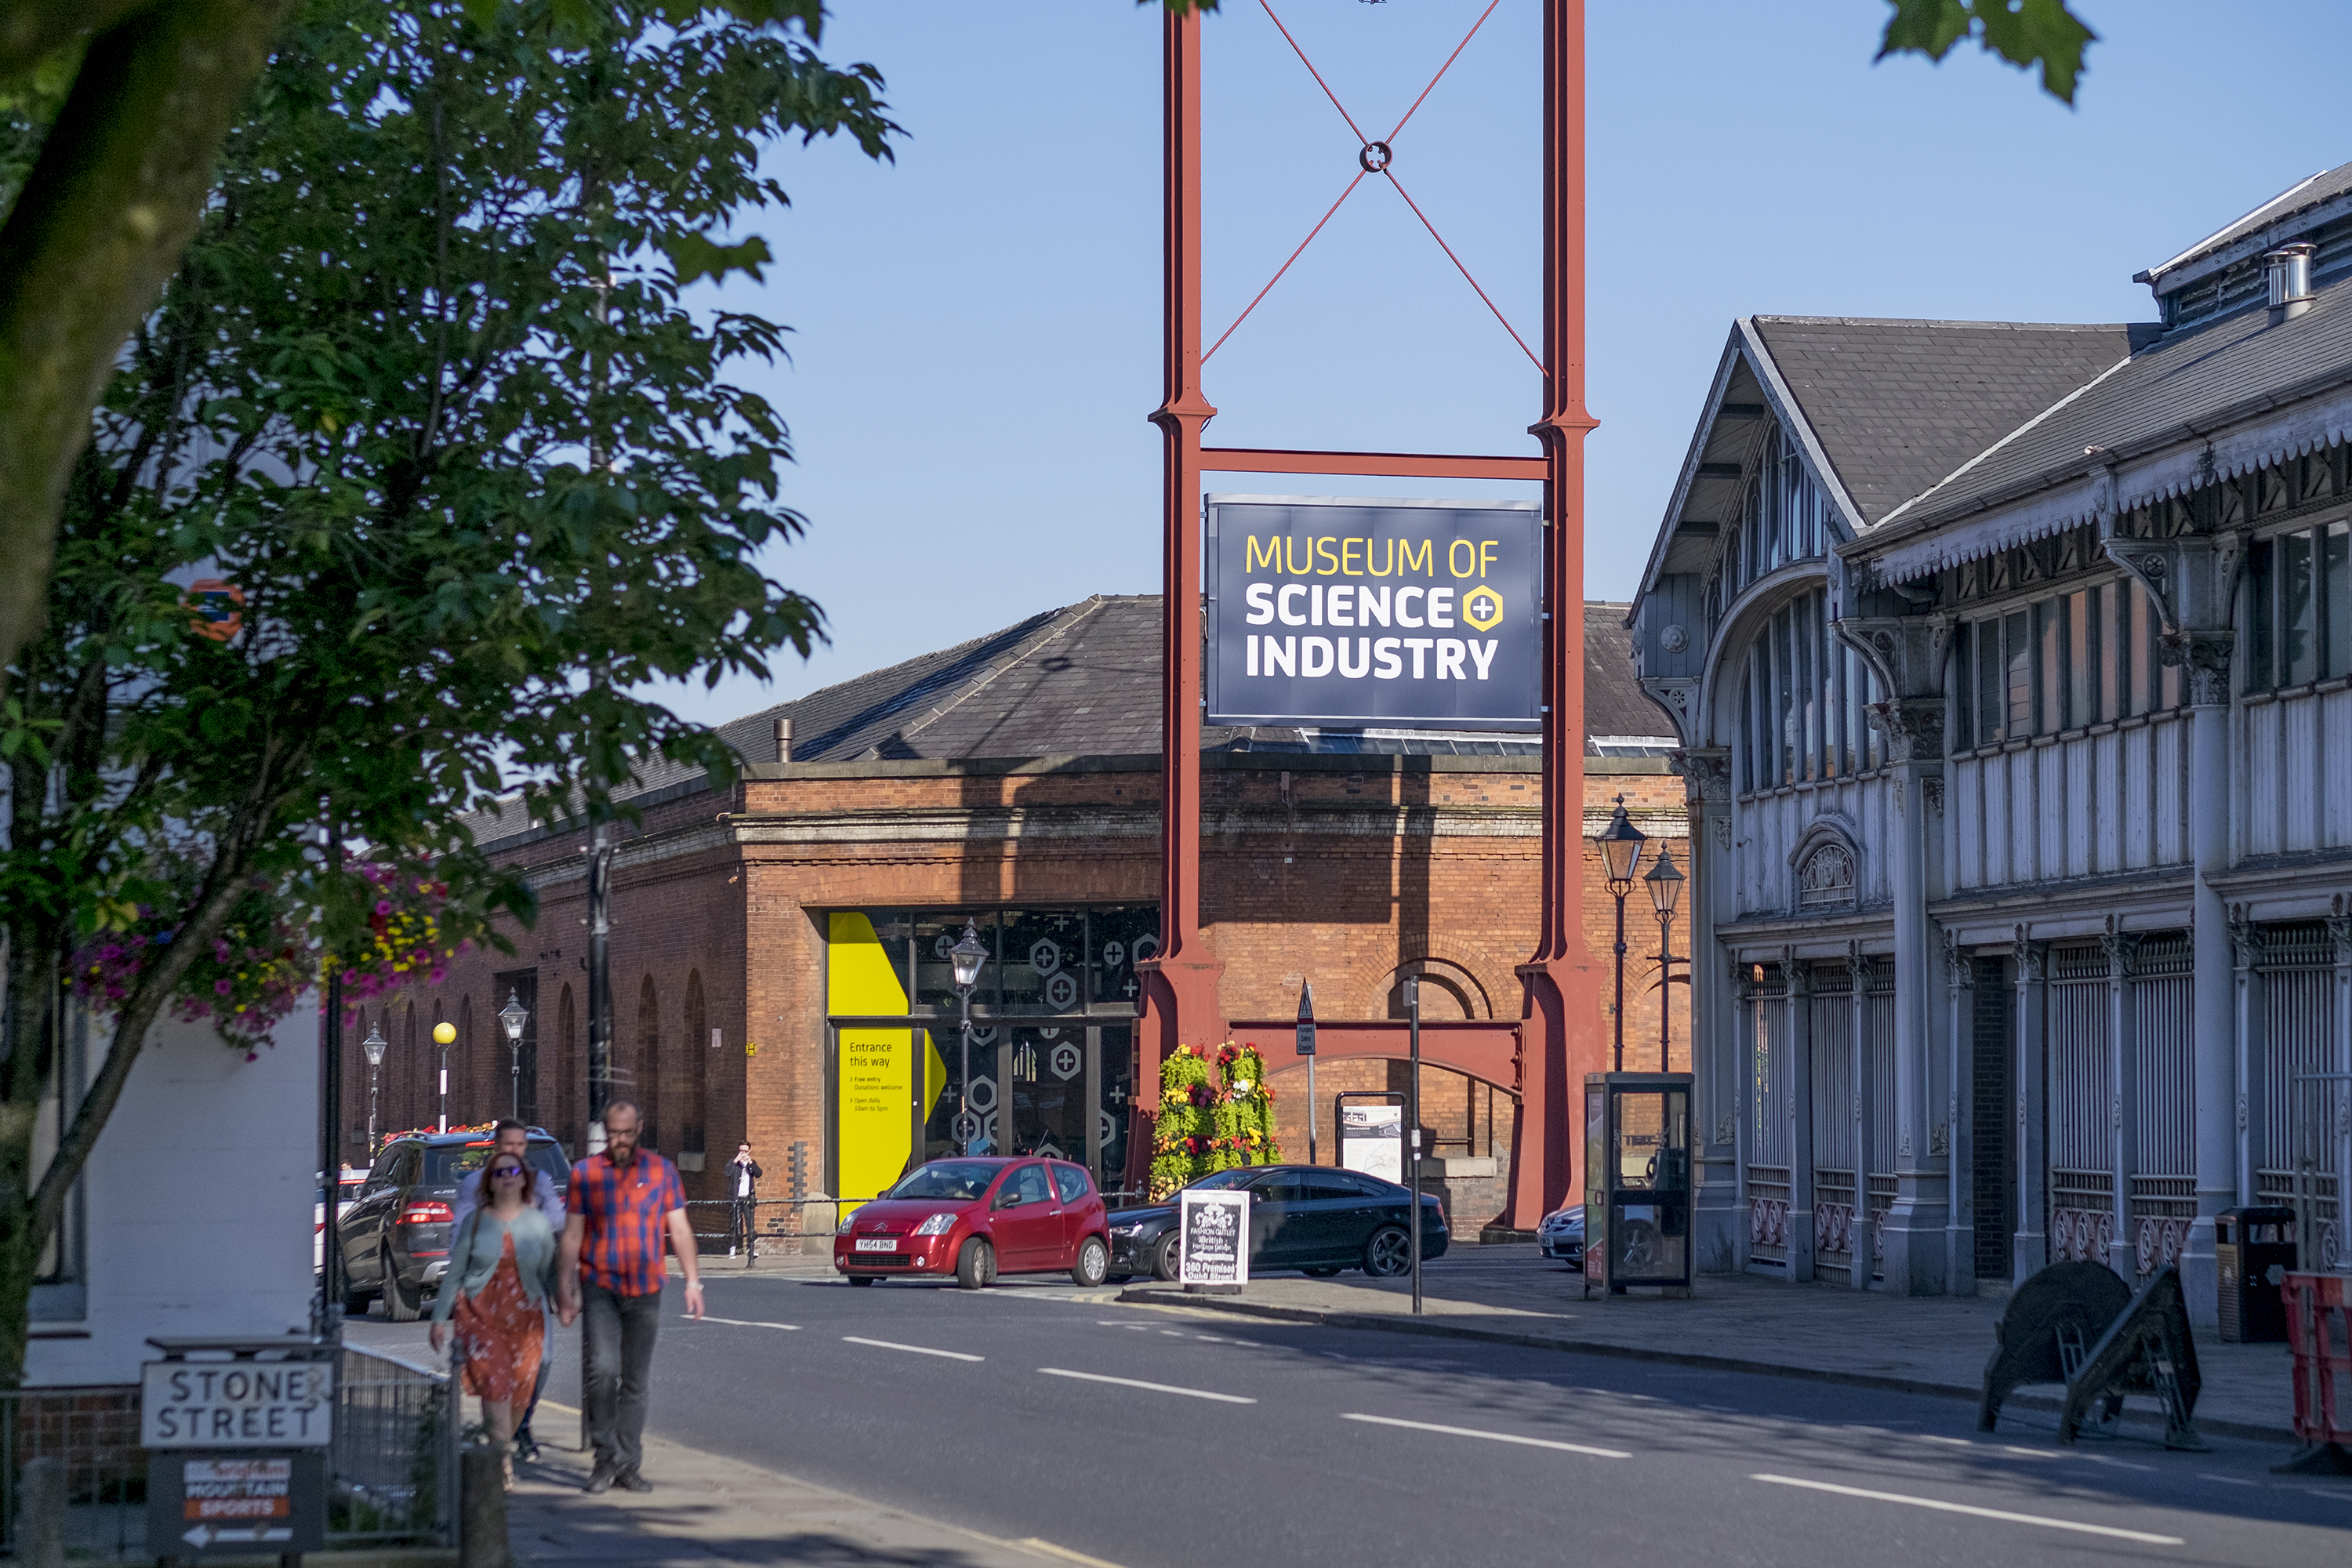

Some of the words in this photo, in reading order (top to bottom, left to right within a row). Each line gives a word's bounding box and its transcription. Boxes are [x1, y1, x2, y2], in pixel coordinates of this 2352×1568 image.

[1246, 535, 1433, 577] MUSEUM
[1448, 539, 1498, 578] OF
[1246, 583, 1454, 628] SCIENCE
[1247, 635, 1498, 680] INDUSTRY
[850, 1043, 892, 1052] Entrance
[850, 1056, 868, 1066] this
[871, 1058, 891, 1068] way
[1190, 1227, 1215, 1236] FASHION
[1215, 1228, 1236, 1236] OUTLET
[1202, 1236, 1224, 1244] British
[859, 1240, 877, 1249] YH54
[170, 1371, 307, 1402] STONE
[158, 1406, 318, 1439] STREET
[199, 1498, 275, 1517] SPORTS
